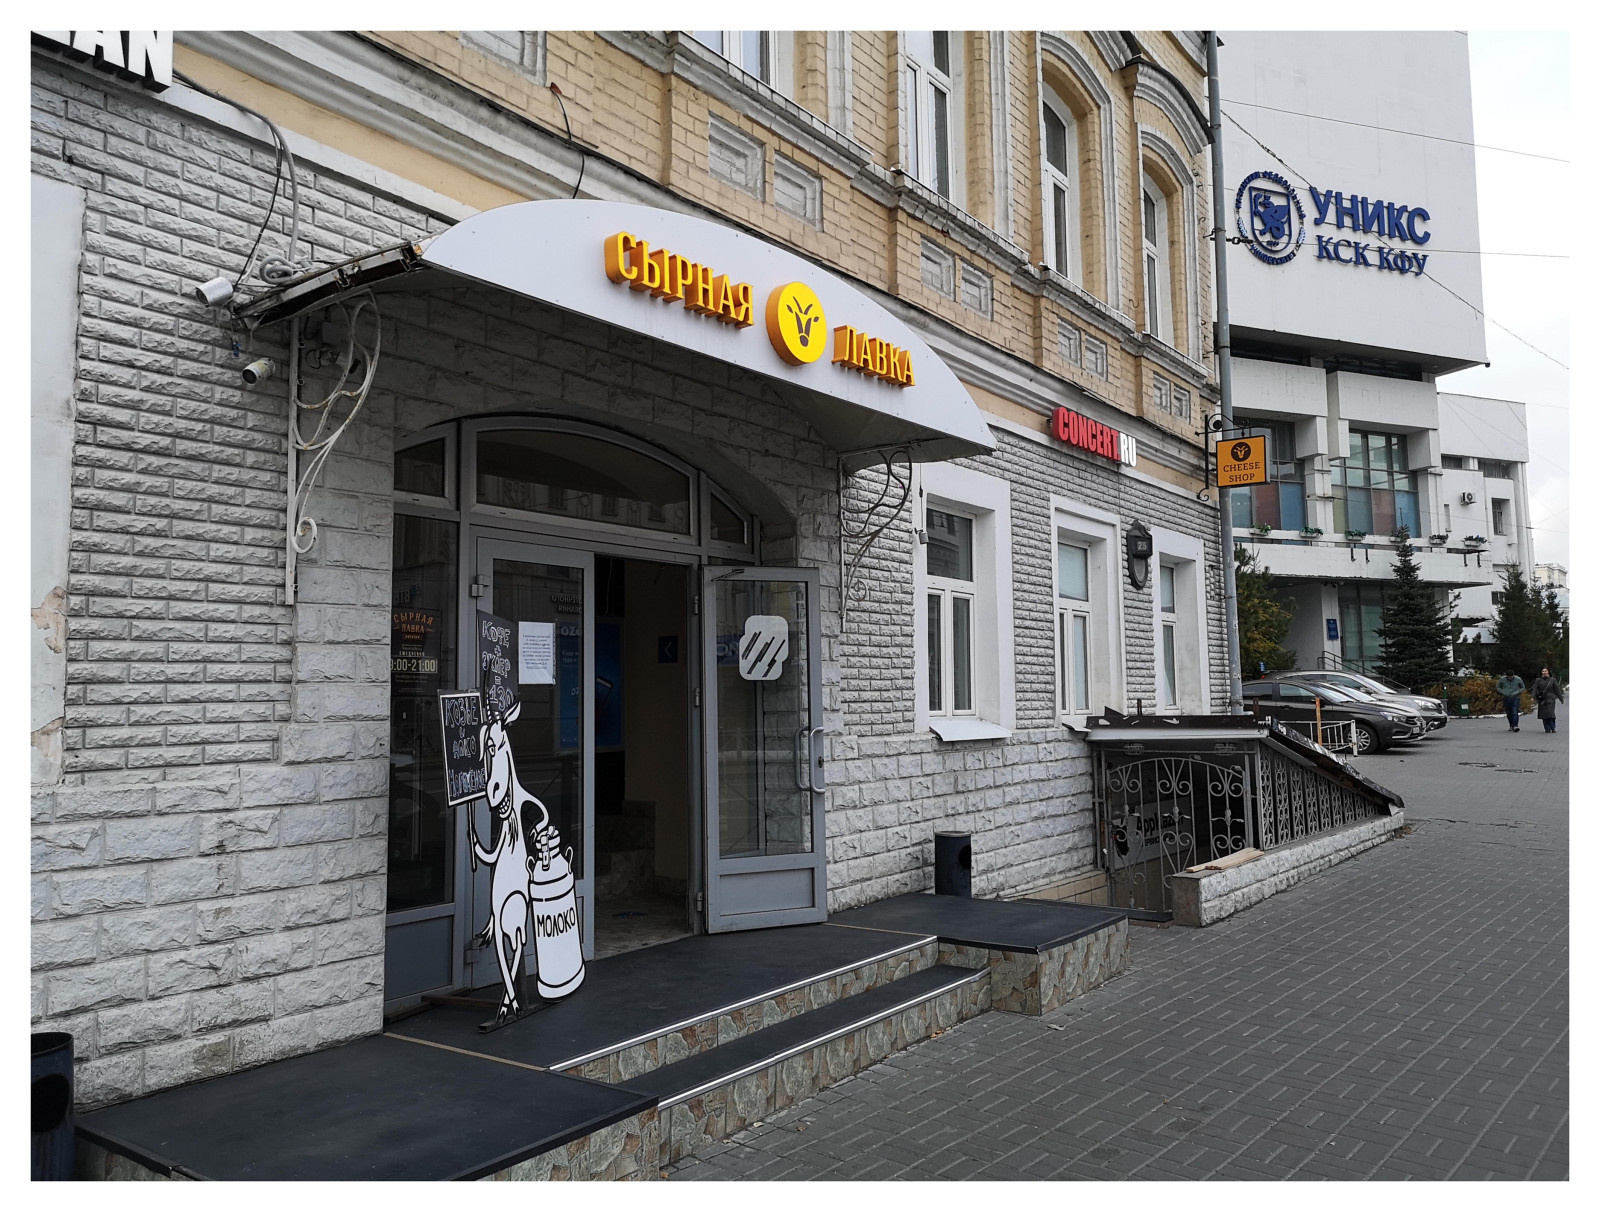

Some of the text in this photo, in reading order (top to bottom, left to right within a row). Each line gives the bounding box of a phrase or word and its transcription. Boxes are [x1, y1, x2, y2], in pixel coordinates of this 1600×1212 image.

[1309, 186, 1431, 245] УНИКС
[1315, 234, 1430, 277] КСК КФУ
[604, 231, 916, 388] СЫРНАЯ ЛАВКА
[1052, 406, 1137, 467] CONCERT.RU
[1223, 461, 1261, 473] CHEESE
[1228, 473, 1256, 483] SHOP
[1137, 541, 1147, 550] 25
[393, 612, 434, 626] СЫРНАЯ
[401, 623, 425, 633] ЛАВКА
[482, 620, 512, 648] КОФЕ
[537, 907, 576, 938] МОЛОКО
